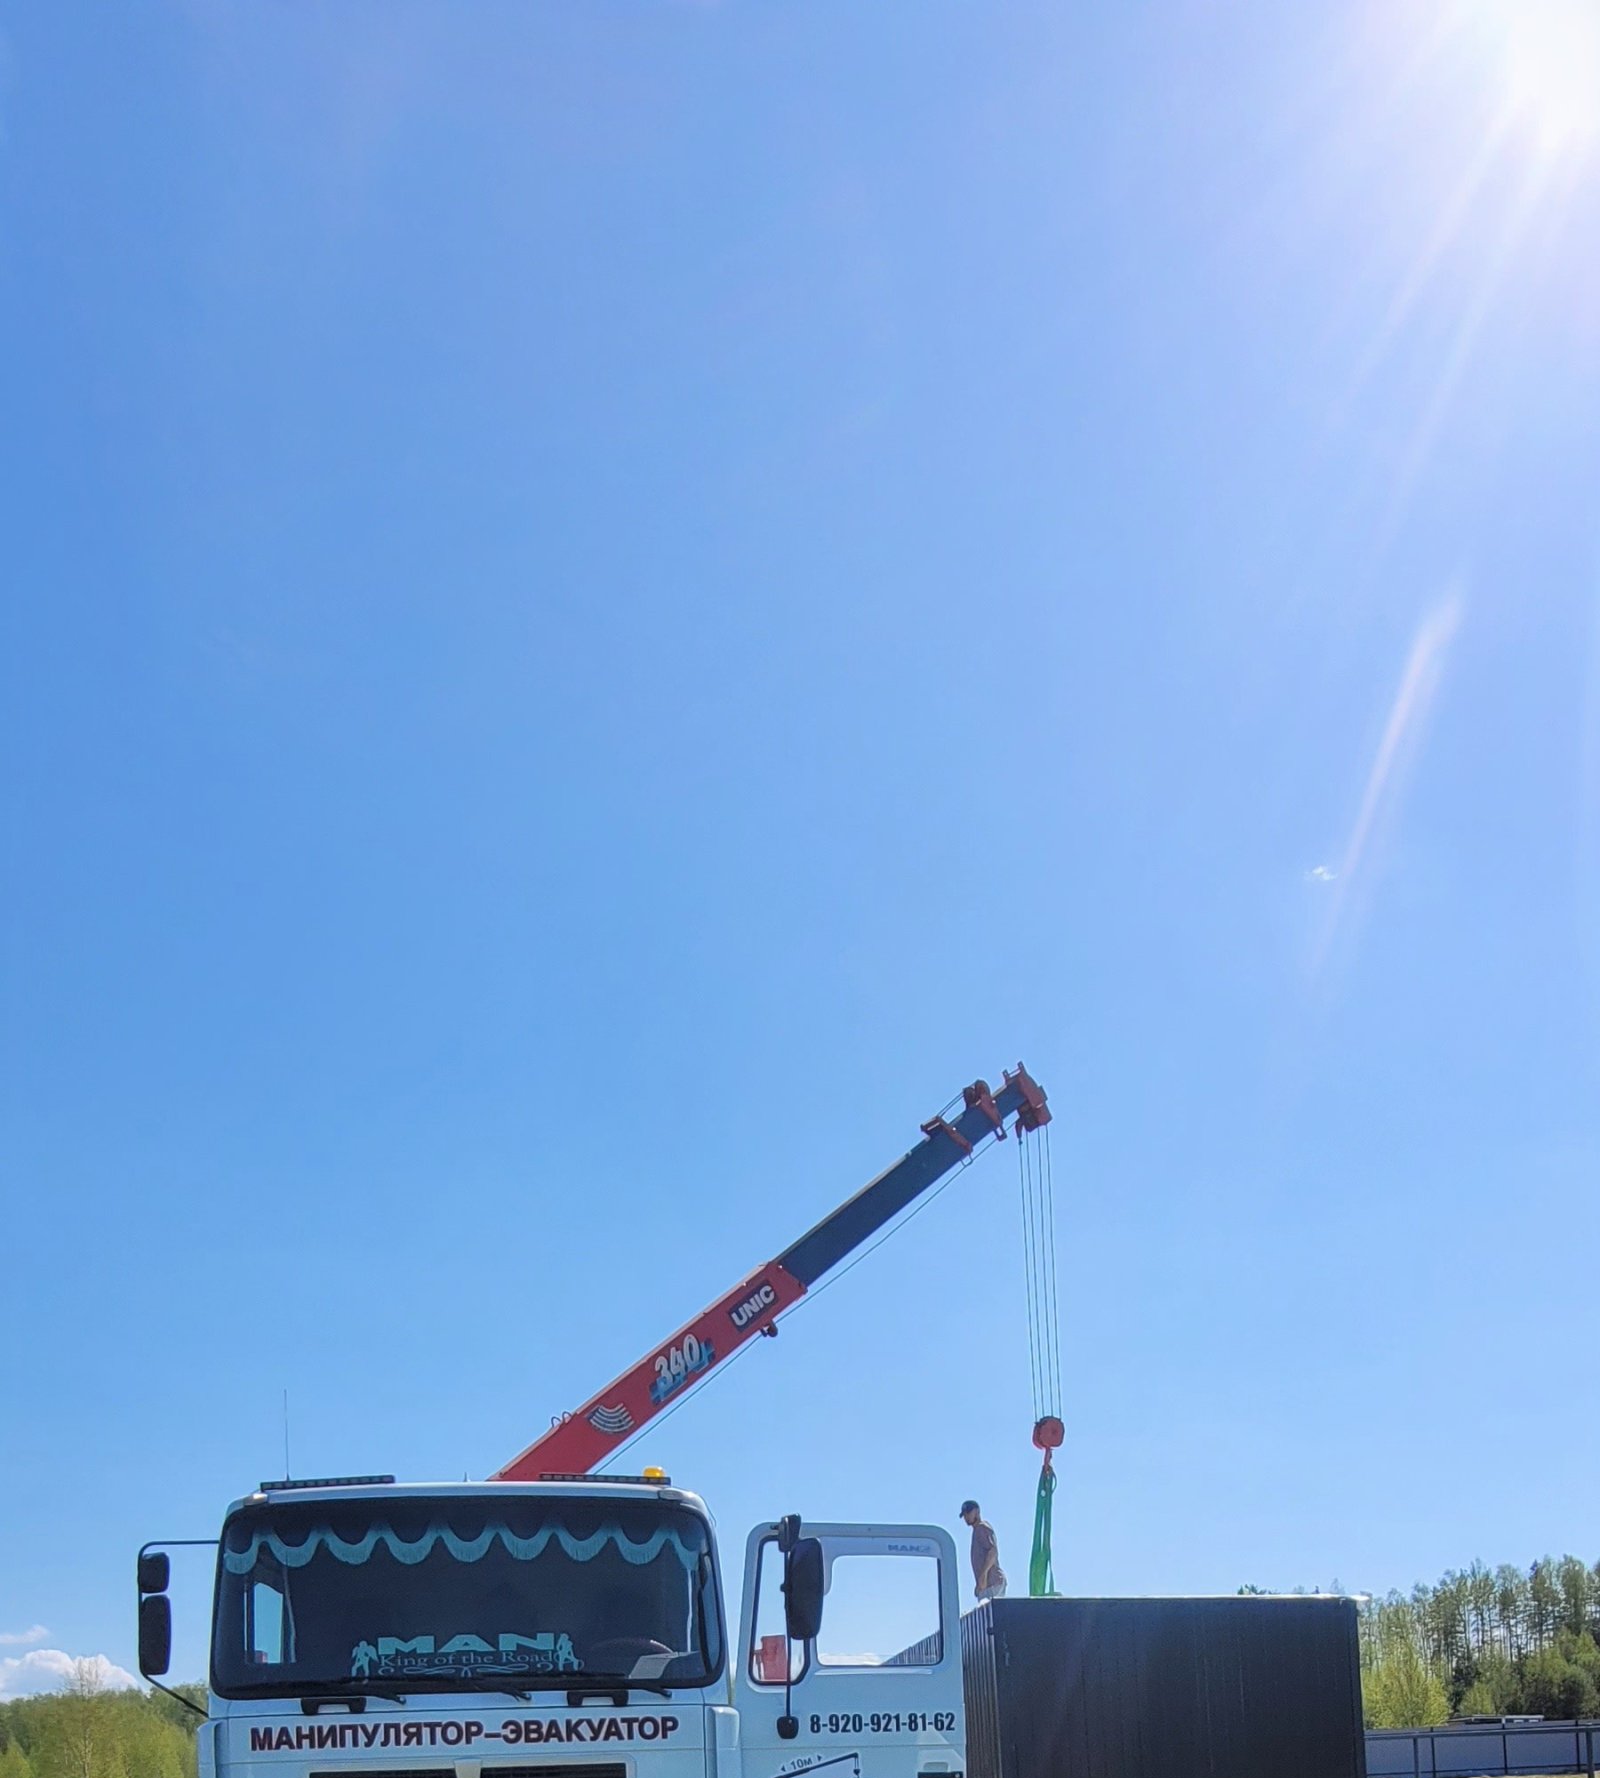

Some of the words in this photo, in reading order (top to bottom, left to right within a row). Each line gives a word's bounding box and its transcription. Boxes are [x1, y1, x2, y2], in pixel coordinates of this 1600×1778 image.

[731, 1285, 775, 1326] UNIC
[655, 1334, 700, 1388] 340
[378, 1633, 554, 1654] MAN
[379, 1654, 428, 1667] King
[434, 1652, 457, 1665] of
[461, 1652, 494, 1664] the
[502, 1650, 554, 1663] Road
[250, 1716, 679, 1752] МАНИПУЛЯТОР-ЭВАКУАТОР
[810, 1712, 956, 1734] 8-920-921-81-62
[790, 1757, 813, 1771] 10м
